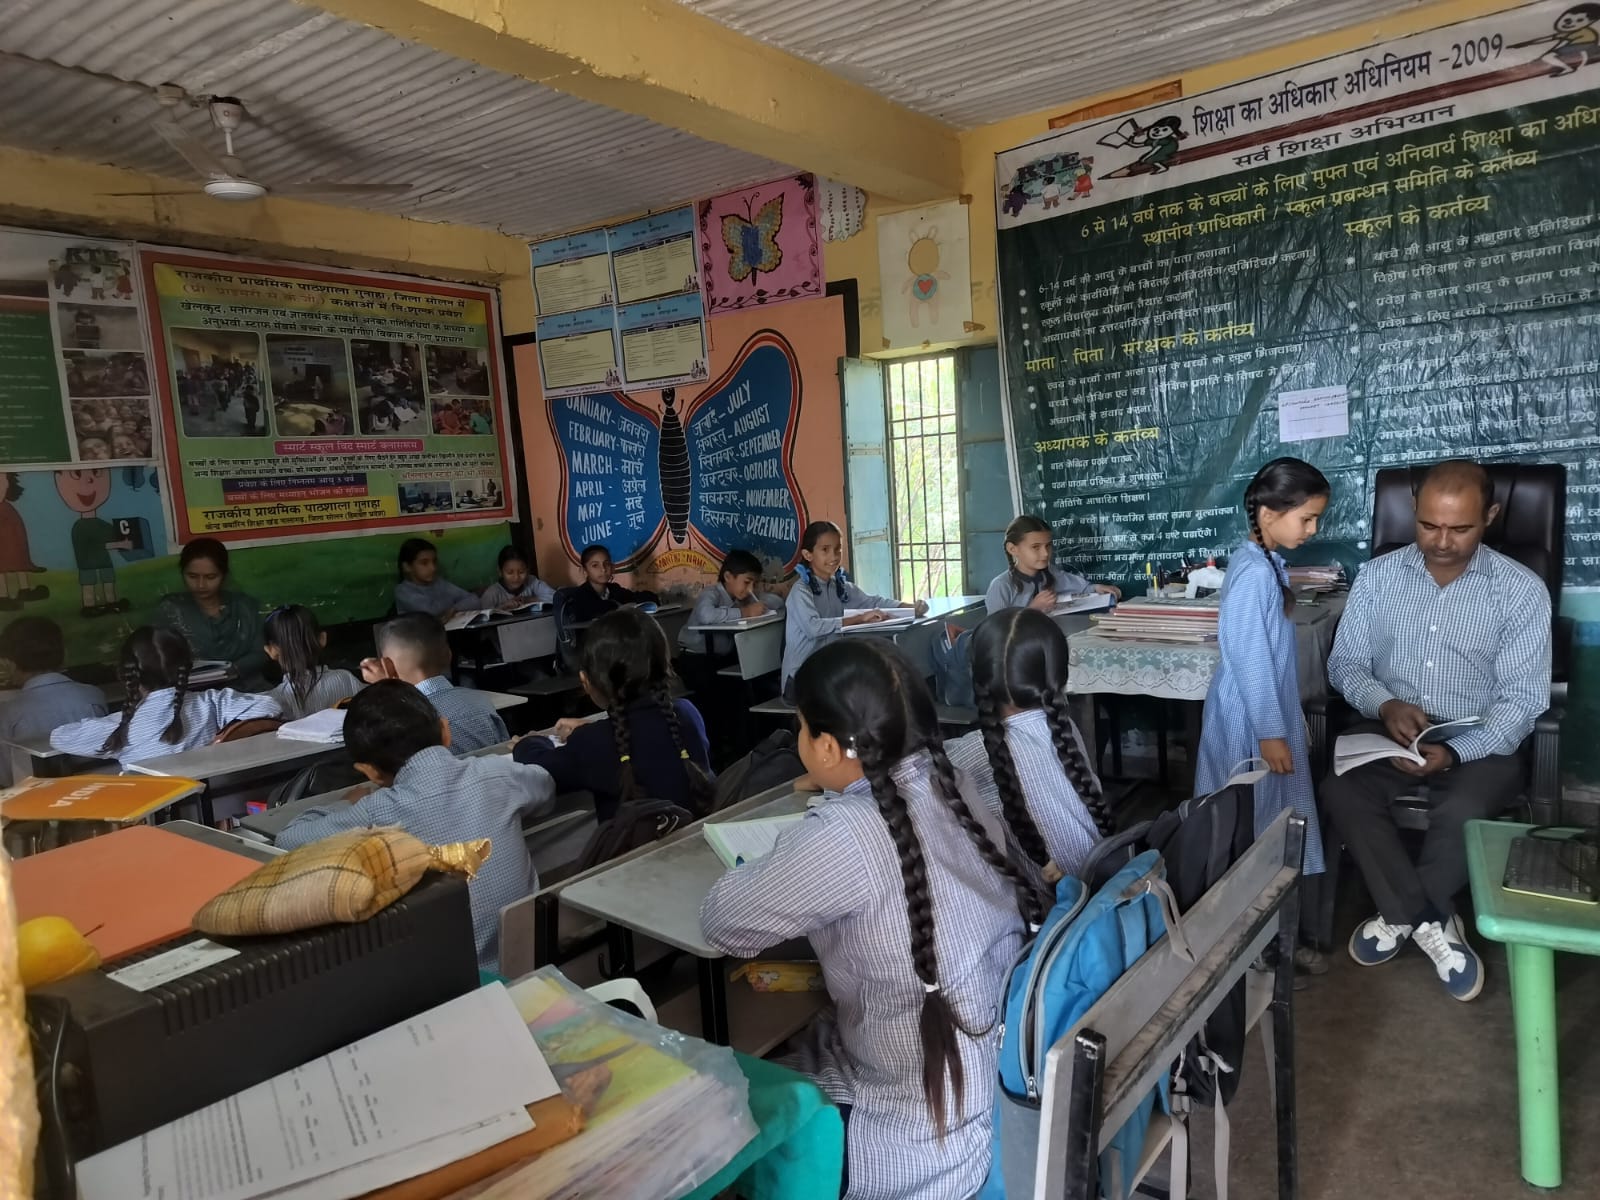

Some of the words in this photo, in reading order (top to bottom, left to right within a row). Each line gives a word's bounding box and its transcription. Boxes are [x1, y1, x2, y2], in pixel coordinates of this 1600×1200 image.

[1192, 103, 1236, 136] शिक्षा
[1240, 98, 1263, 121] का
[1269, 77, 1337, 119] अधिकार
[1345, 51, 1431, 95] अधिनियम
[1439, 33, 1504, 70] -2009
[1233, 145, 1270, 170] सर्व
[1280, 130, 1341, 158] शिक्षा
[1350, 104, 1456, 137] अभियान
[1081, 225, 1090, 239] 6
[1092, 218, 1106, 232] से
[1111, 216, 1128, 231] 14
[1133, 203, 1154, 224] वर्ष
[1158, 204, 1184, 220] तक
[1187, 193, 1204, 213] के
[1208, 179, 1247, 207] बच्चों
[1252, 176, 1269, 198] के
[1273, 169, 1308, 193] लिए
[1312, 163, 1347, 188] मुफ्त
[1352, 152, 1379, 179] एवं
[1386, 138, 1456, 168] अनिवार्य
[1463, 126, 1513, 153] शिक्षा
[1520, 118, 1548, 139] का
[1141, 223, 1192, 247] स्थानीय
[1197, 204, 1265, 237] प्राधिकारी
[1285, 196, 1326, 219] स्कूल
[1329, 180, 1389, 207] प्रबन्धन
[1394, 167, 1449, 193] समिति
[1455, 159, 1474, 182] के
[1479, 149, 1540, 175] कर्तव्य
[1342, 213, 1393, 240] स्कूल
[1397, 203, 1420, 226] के
[1425, 193, 1492, 221] कर्तव्य
[1456, 235, 1470, 247] के
[1118, 266, 1128, 276] के
[1173, 254, 1193, 264] पता
[1464, 256, 1476, 269] के
[175, 270, 233, 283] राजकीय
[238, 276, 293, 289] प्राथमिक
[296, 282, 349, 296] पाठशाला
[394, 291, 421, 303] जिला
[1498, 275, 1510, 287] के
[330, 297, 374, 310] कक्षाओं
[378, 301, 387, 310] में
[203, 316, 241, 329] अनुभवी
[245, 320, 271, 330] स्टाफ
[377, 328, 404, 340] विकास
[1024, 356, 1056, 373] माता
[1073, 347, 1105, 365] पिता
[1122, 336, 1178, 357] संरक्षक
[1180, 327, 1200, 346] के
[1203, 321, 1256, 342] कर्तव्य
[727, 379, 751, 414] JULY
[566, 396, 613, 425] JANUARY
[617, 415, 650, 446] जनवरी
[696, 428, 727, 453] अगस्त
[733, 403, 771, 436] AUGUST
[1569, 410, 1597, 423] 220
[282, 440, 306, 452] स्मार्ट
[310, 441, 334, 454] स्कूल
[356, 440, 377, 451] स्मार्ट
[568, 421, 617, 451] FEBRUARY
[698, 446, 738, 472] सितम्बर
[738, 429, 782, 459] SEPTEMBER
[1033, 434, 1091, 454] अध्यापक
[1093, 428, 1109, 447] के
[1112, 424, 1161, 444] कर्तव्य
[572, 450, 613, 475] MARCH
[621, 457, 645, 476] मार्च
[699, 467, 743, 489] अक्टूबर
[743, 458, 780, 482] OCTOBER
[575, 480, 605, 498] APRIL
[746, 488, 792, 511] NOVEMBER
[202, 506, 251, 521] राजकीय
[254, 502, 301, 518] प्राथमिक
[303, 500, 350, 514] पाठशाला
[577, 502, 603, 523] MAY
[699, 505, 743, 532] दिसम्बर
[746, 512, 797, 544] DECEMBER
[119, 519, 130, 535] C
[581, 520, 613, 545] JUNE
[626, 510, 646, 530] जून
